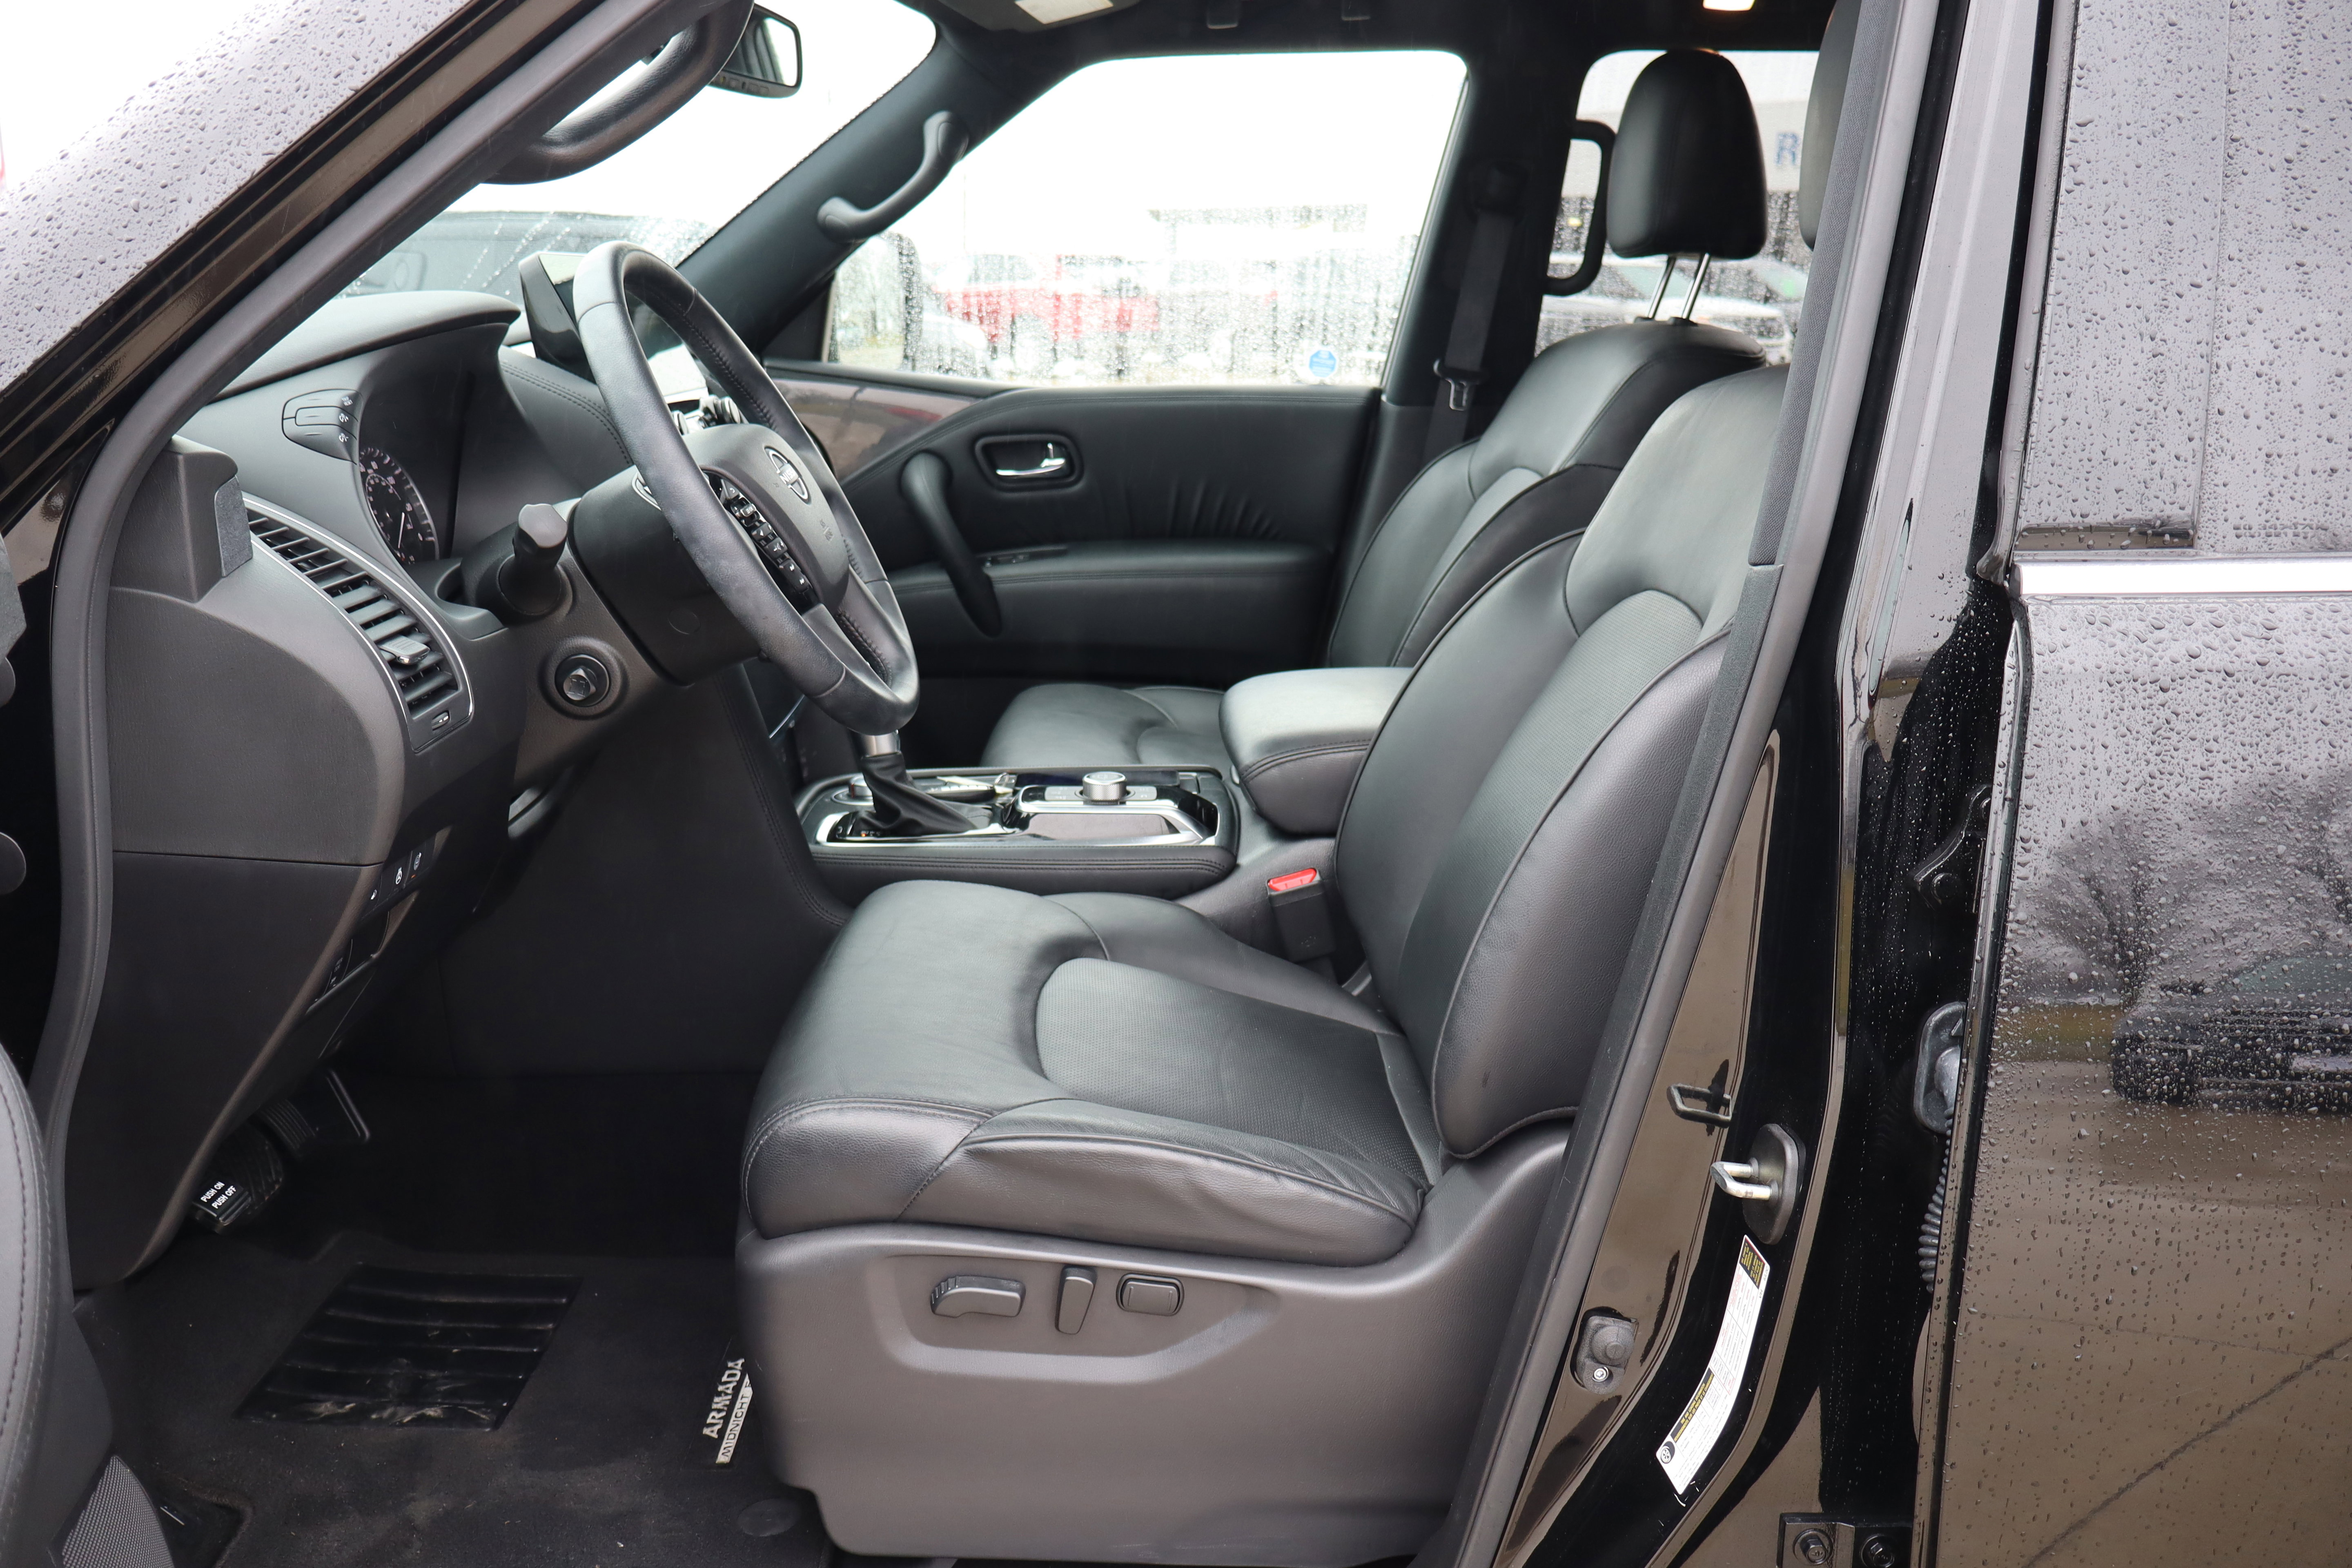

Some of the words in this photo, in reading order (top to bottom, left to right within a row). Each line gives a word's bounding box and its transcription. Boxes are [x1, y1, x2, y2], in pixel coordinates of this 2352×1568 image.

[200, 1188, 218, 1203] PUSH
[214, 1181, 225, 1190] ON
[212, 1194, 228, 1209] PUSH
[225, 1185, 236, 1196] OFF
[702, 1359, 745, 1439] ARMADA
[722, 1394, 749, 1457] MIDNIGHT
